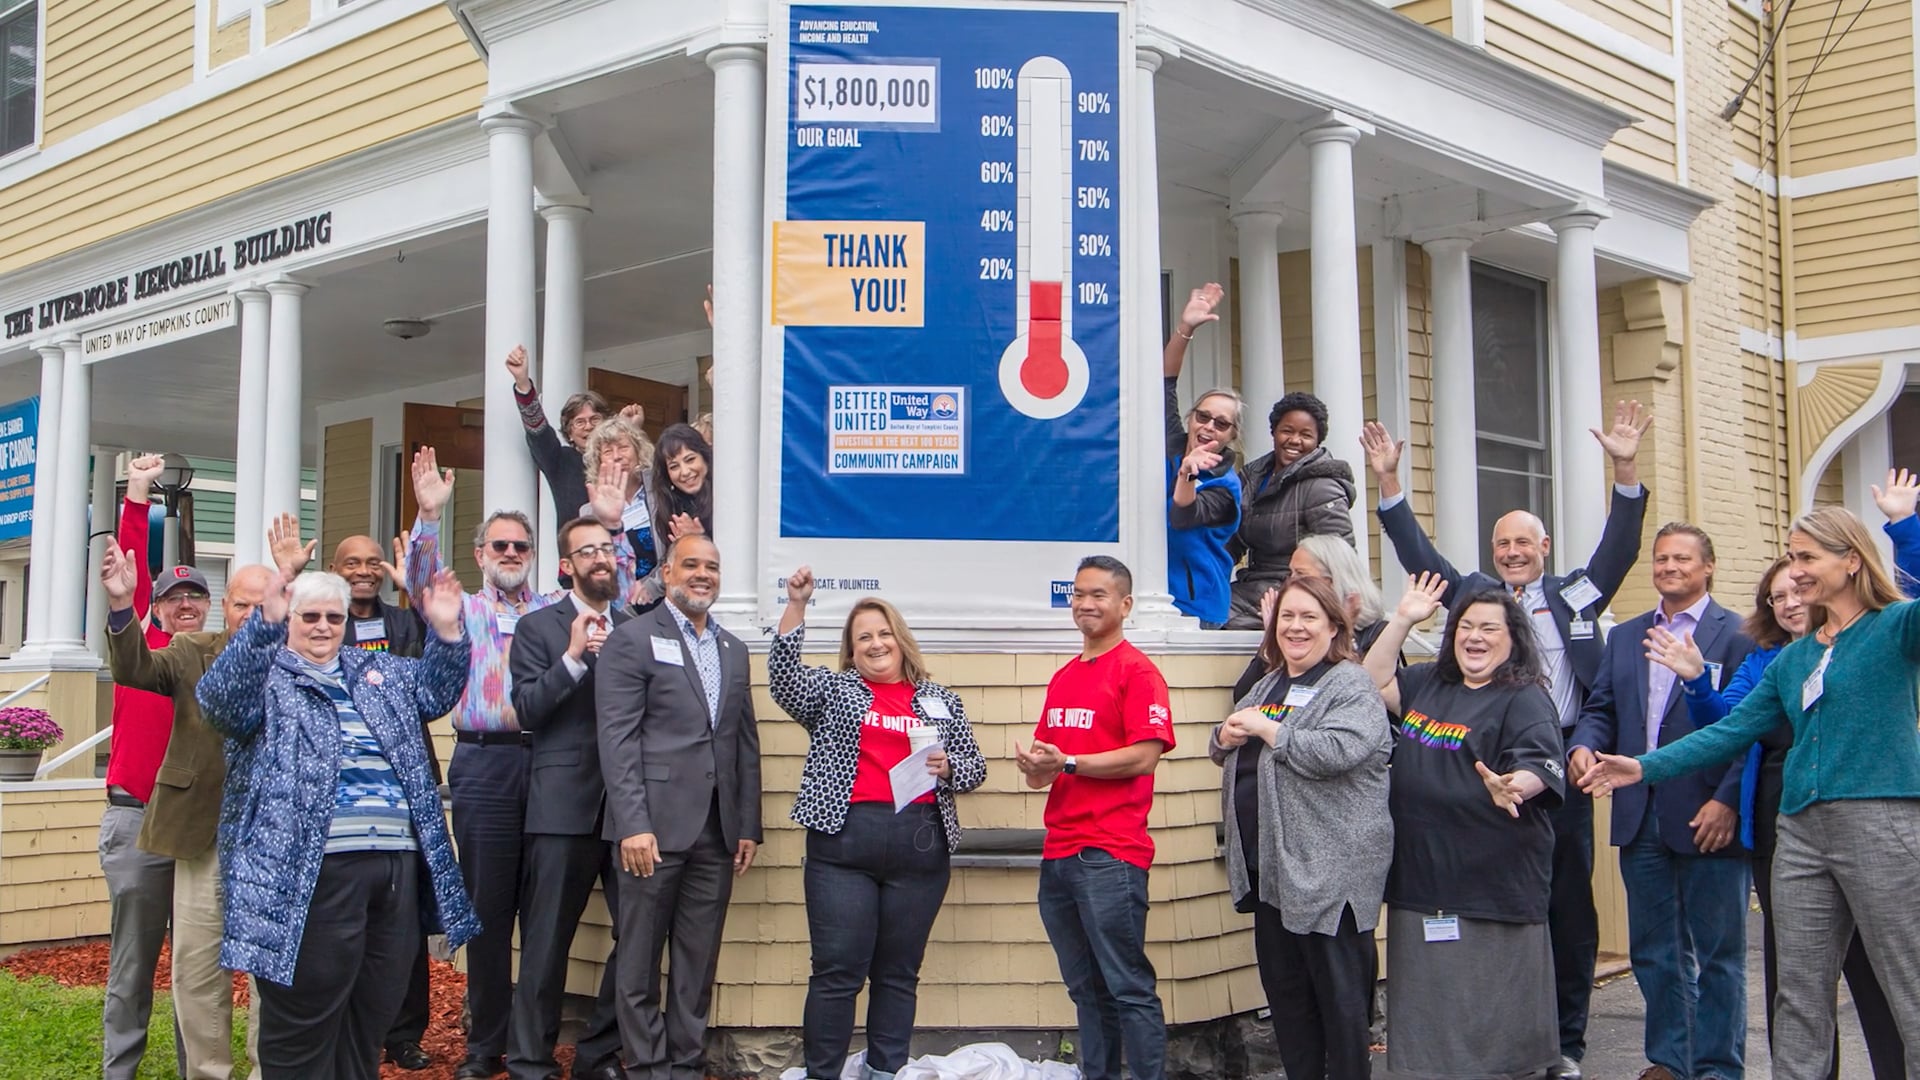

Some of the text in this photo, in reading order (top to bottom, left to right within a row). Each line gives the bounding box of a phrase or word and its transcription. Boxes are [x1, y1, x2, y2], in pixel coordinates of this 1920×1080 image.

[800, 21, 879, 33] ADVANCING EDUCATION,
[800, 33, 869, 44] INCOME AND HEALTH
[975, 68, 1014, 89] 100%
[804, 75, 930, 111] $1,800,000
[1078, 92, 1110, 114] 90%
[981, 115, 1014, 137] 80%
[797, 128, 861, 147] OUR GOAL
[1078, 140, 1109, 161] 70%
[981, 162, 1014, 183] 60%
[1078, 187, 1110, 209] 50%
[981, 210, 1014, 232] 40%
[823, 234, 908, 268] THANK
[1079, 234, 1111, 256] 30%
[4, 211, 332, 339] THE LIVERMORE MEMORIAL BUILDING
[979, 258, 1013, 280] 20%
[851, 278, 906, 312] YOU!
[1078, 283, 1108, 305] 10%
[86, 300, 231, 354] UNITED WAY OF TOMPKINS COUNTY
[835, 392, 887, 410] BETTER
[892, 395, 929, 405] United
[835, 413, 887, 430] UNITED
[906, 406, 928, 419] Way
[835, 454, 958, 469] COMMUNITY CAMPAIGN
[174, 566, 191, 579] C
[839, 578, 882, 591] VOLUNTEER.
